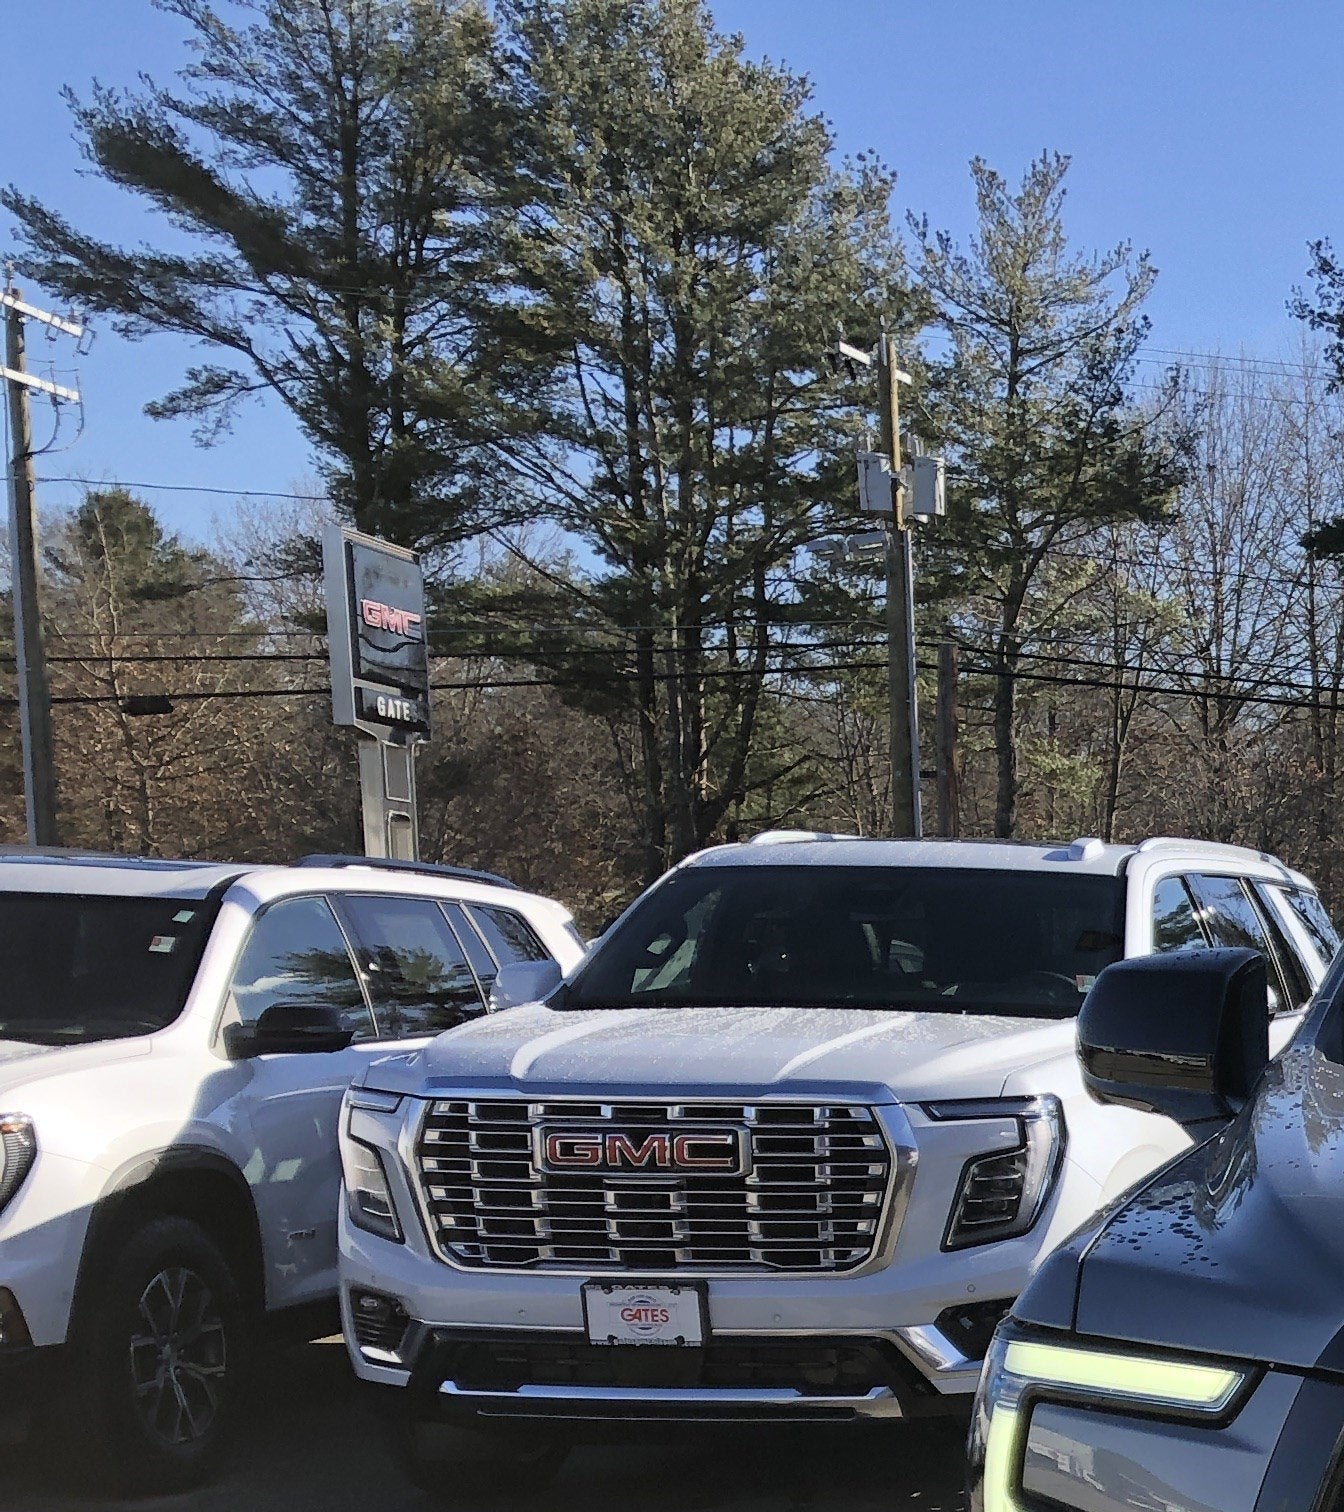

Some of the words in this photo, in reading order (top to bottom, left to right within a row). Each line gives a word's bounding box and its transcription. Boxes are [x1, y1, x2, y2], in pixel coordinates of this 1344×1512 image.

[361, 599, 422, 640] GMC
[546, 1132, 733, 1167] GMC
[621, 1308, 670, 1322] GATES
